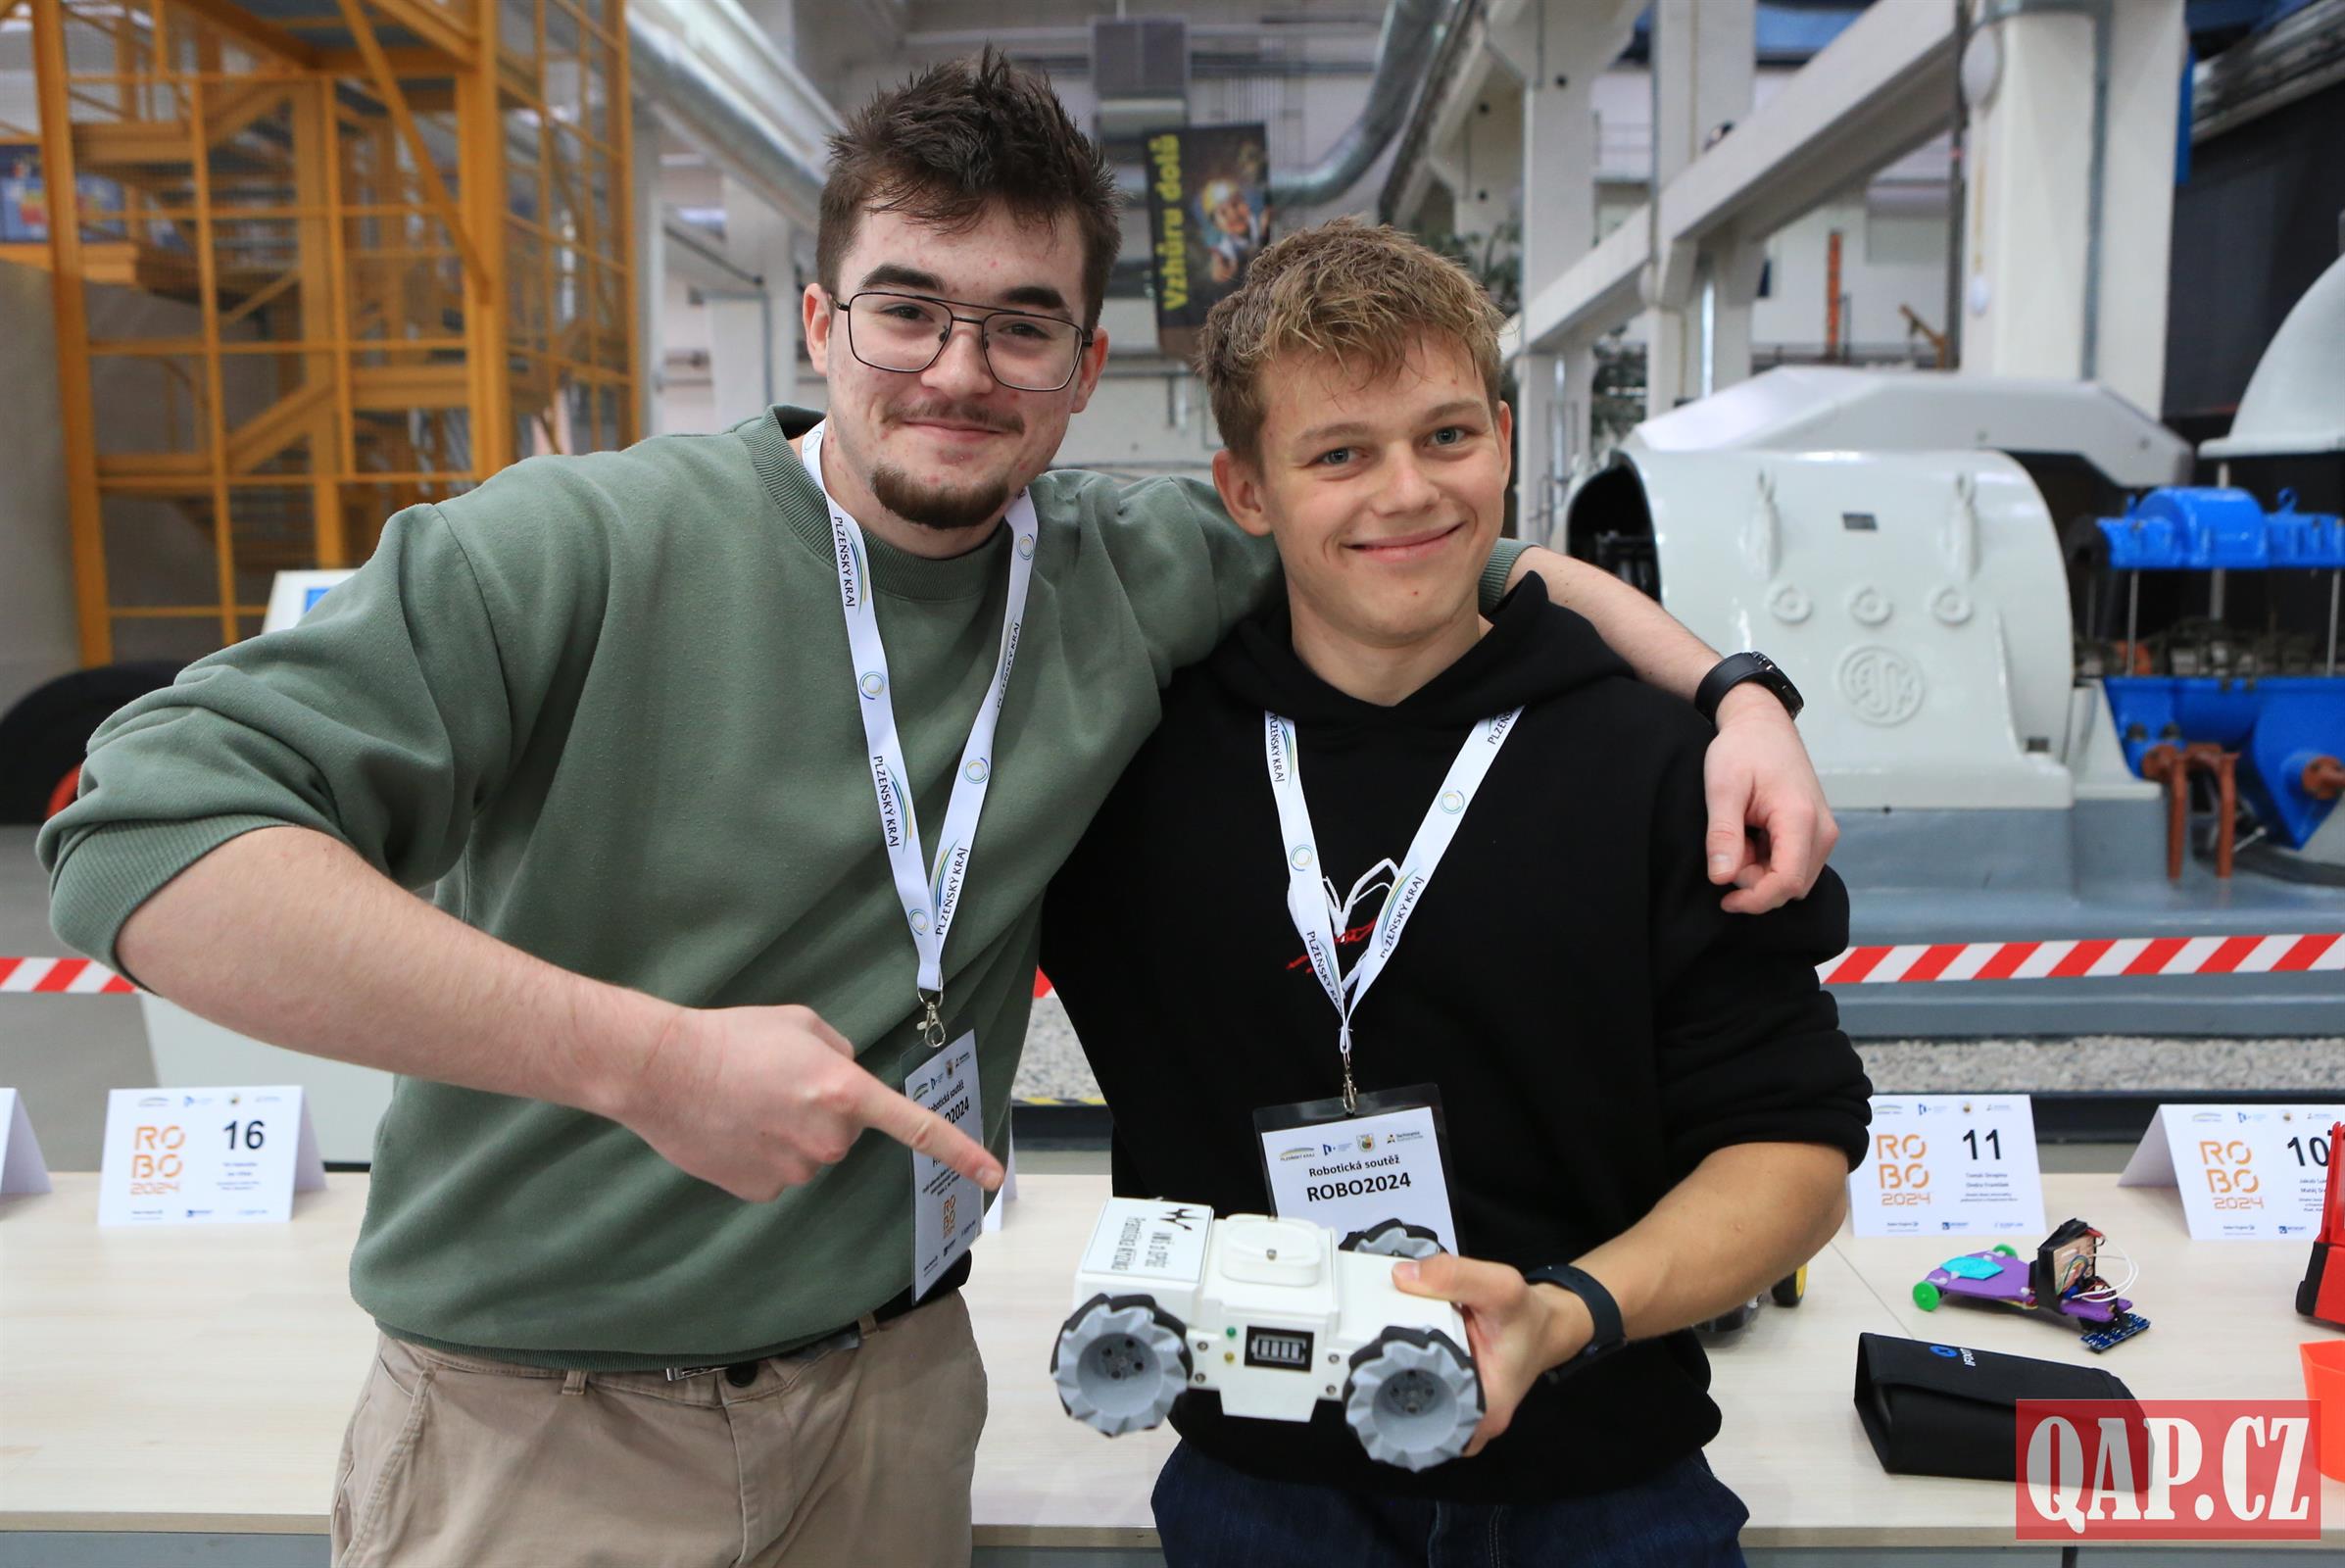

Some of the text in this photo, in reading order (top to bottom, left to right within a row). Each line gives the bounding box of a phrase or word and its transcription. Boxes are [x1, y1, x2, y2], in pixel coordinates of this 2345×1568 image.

[1155, 208, 1188, 311] Vzhůru
[834, 516, 856, 607] PLZEŇSKÝ KRAJ
[1010, 622, 1020, 649] KRAJ
[1488, 711, 1512, 745] PLZEŇS
[1270, 714, 1286, 783] PLZEŇSKÝ KRAJ
[873, 756, 900, 848] PLZEŇSKÝ KRAJ
[935, 847, 969, 935] PLZEŇSKÝ KRAJ
[1380, 876, 1425, 958] PLZEŇSKÝ KRAJ
[134, 1125, 185, 1151] RO
[223, 1120, 265, 1151] 16
[1877, 1134, 1927, 1160] RO
[1963, 1129, 2001, 1160] 11
[1308, 1154, 1401, 1177] Robotická soutěž
[2199, 1140, 2252, 1165] RO
[2287, 1136, 2329, 1168] 10
[131, 1154, 183, 1179] BO
[1879, 1163, 1930, 1190] BO
[130, 1182, 181, 1196] 2024
[1306, 1172, 1412, 1202] ROBO2024
[2206, 1169, 2259, 1194] BO
[1881, 1193, 1930, 1205] 2024
[2213, 1197, 2265, 1209] 2024
